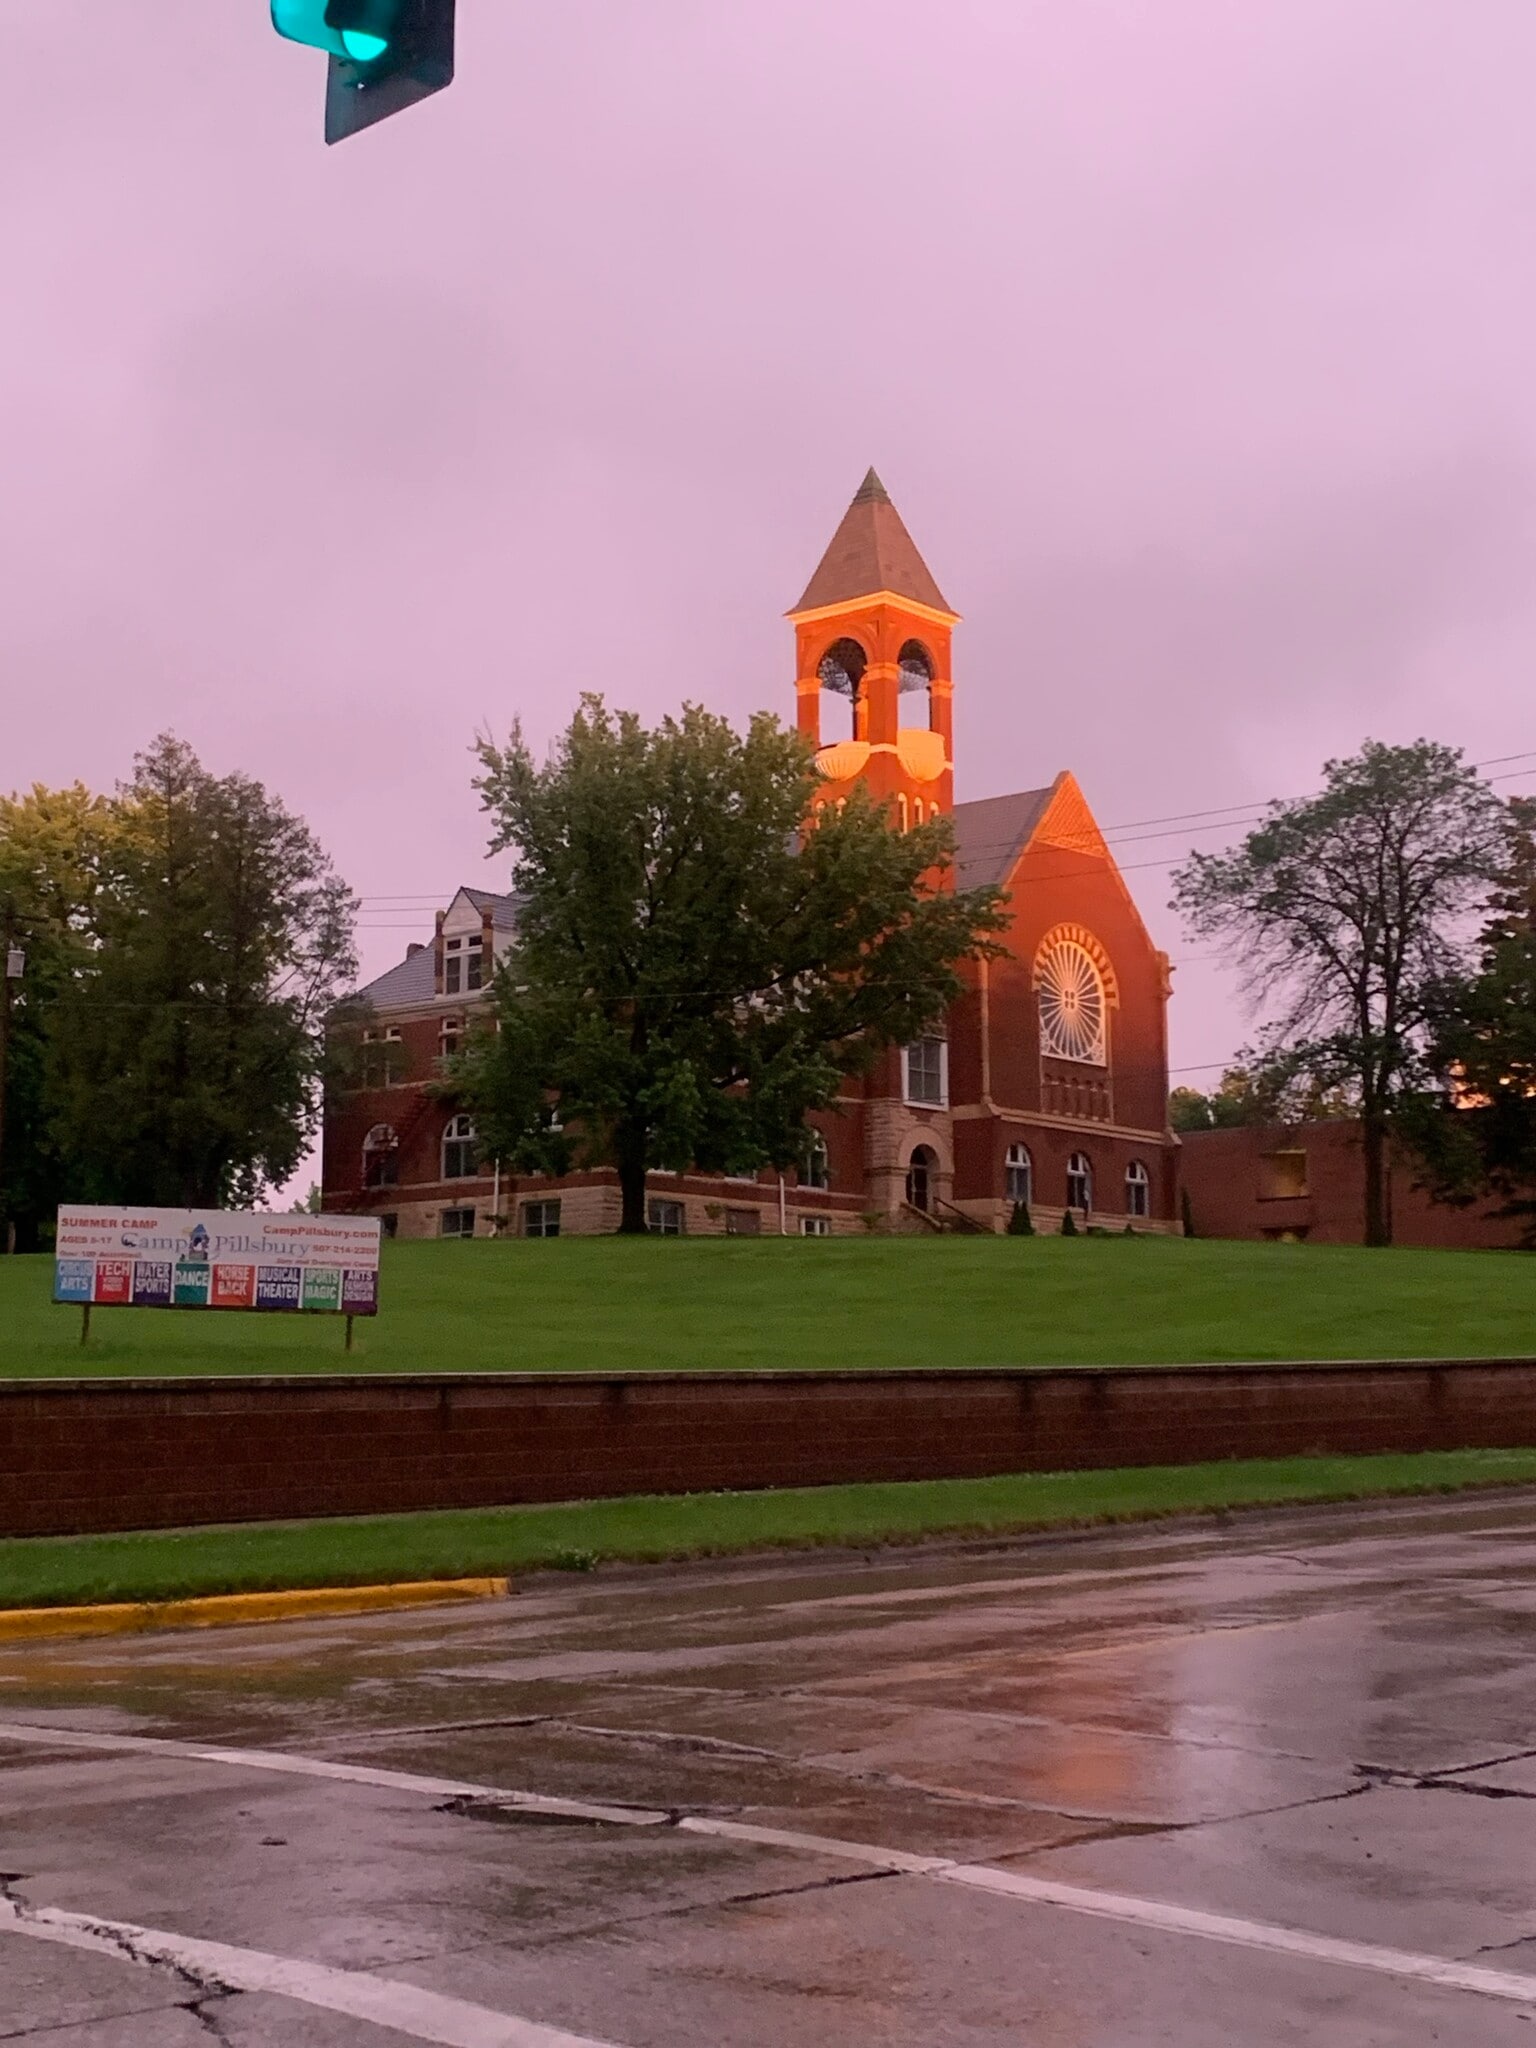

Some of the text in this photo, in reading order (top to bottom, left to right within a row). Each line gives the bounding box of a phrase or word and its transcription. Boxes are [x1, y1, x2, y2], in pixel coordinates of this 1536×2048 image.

[61, 1218, 158, 1229] SUMMER CAMP
[60, 1235, 88, 1244] AGES
[263, 1225, 378, 1239] CampPillsbury.com
[121, 1232, 311, 1258] Camp Pillsbury
[59, 1261, 93, 1276] CIRCUS
[97, 1260, 130, 1276] TECH
[136, 1262, 170, 1278] WATER
[217, 1265, 250, 1280] HORSE
[258, 1266, 298, 1282] MUSICAL
[347, 1271, 373, 1280] ARTS
[60, 1276, 89, 1290] ARTS
[175, 1270, 209, 1286] DANCE
[304, 1268, 339, 1284] SPORTS
[135, 1278, 170, 1293] SPORTS
[217, 1280, 247, 1295] BACK
[258, 1282, 298, 1299] THEATER
[304, 1284, 337, 1300] MAGIC
